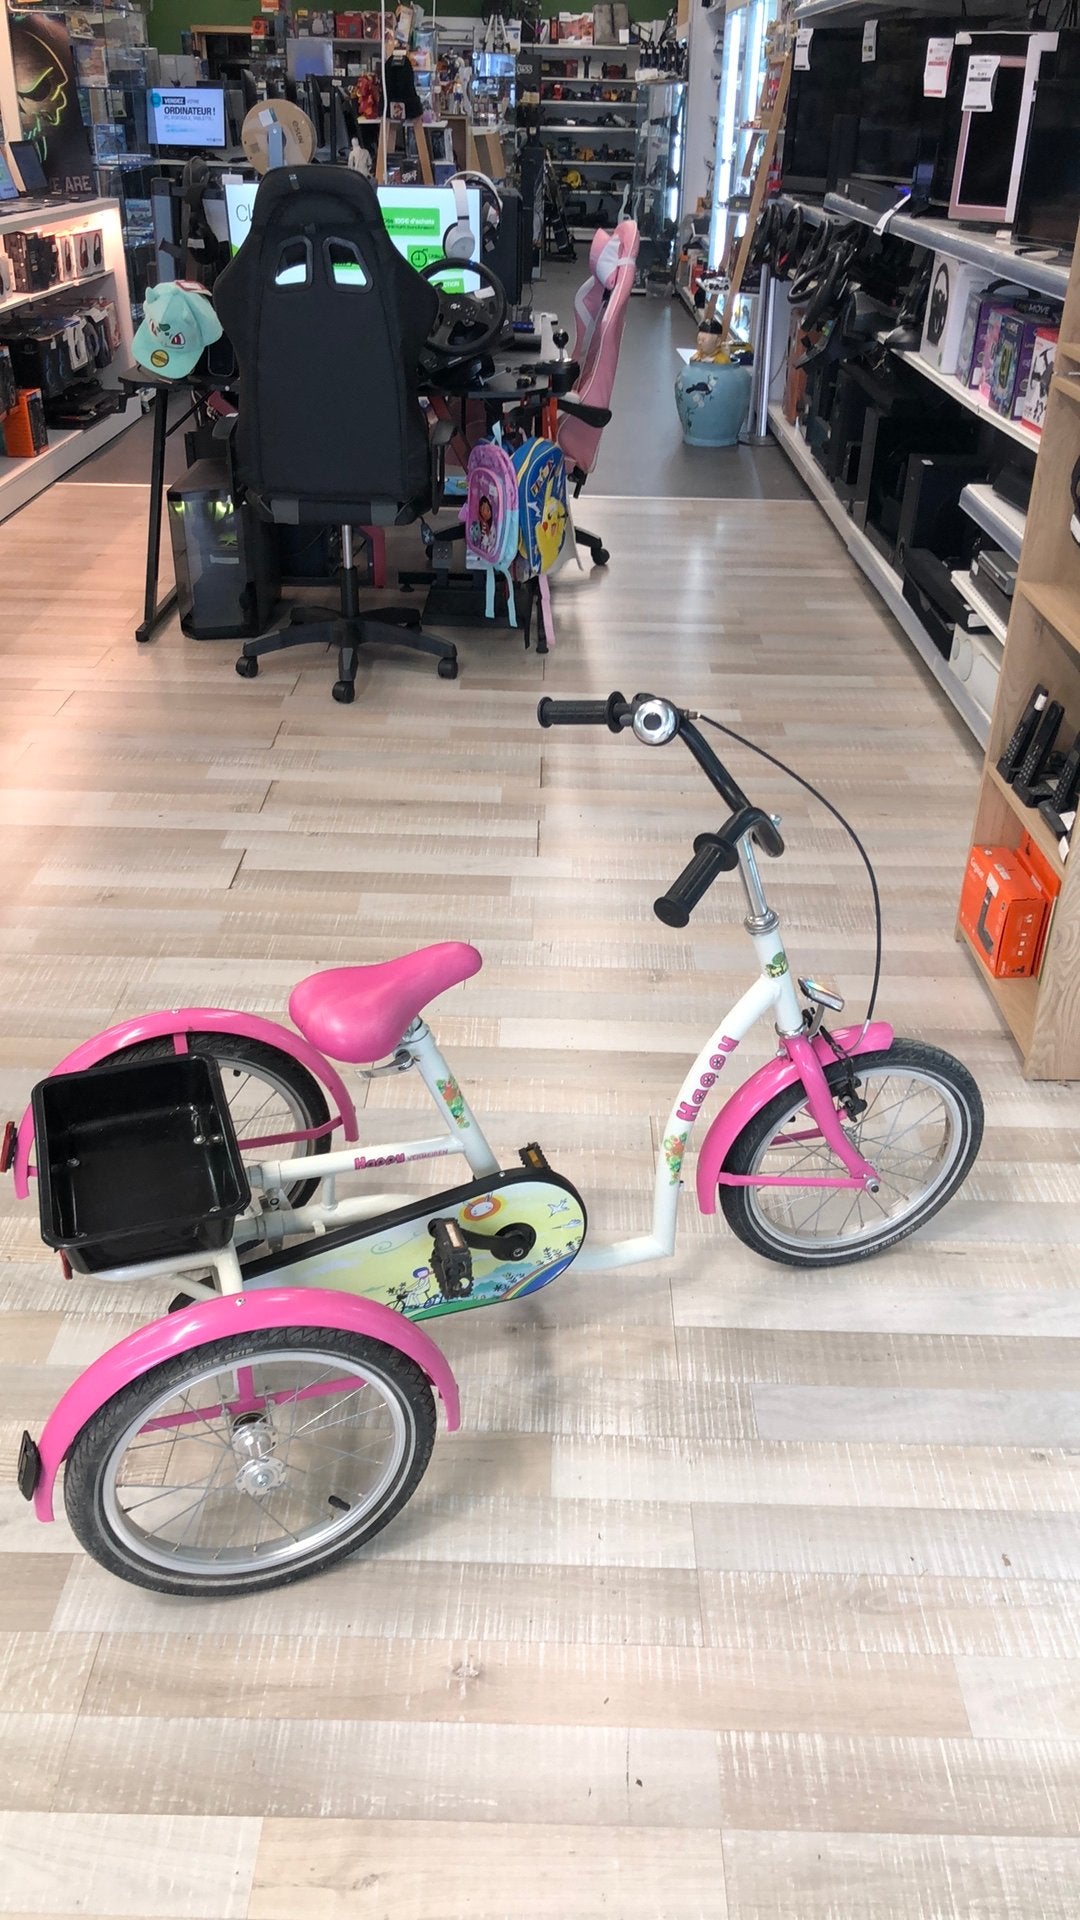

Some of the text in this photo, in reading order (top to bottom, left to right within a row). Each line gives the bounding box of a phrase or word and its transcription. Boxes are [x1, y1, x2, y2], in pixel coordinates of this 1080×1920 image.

[164, 106, 212, 116] ORDINATEUR
[51, 175, 92, 192] E ARE
[354, 1152, 406, 1170] Happy
